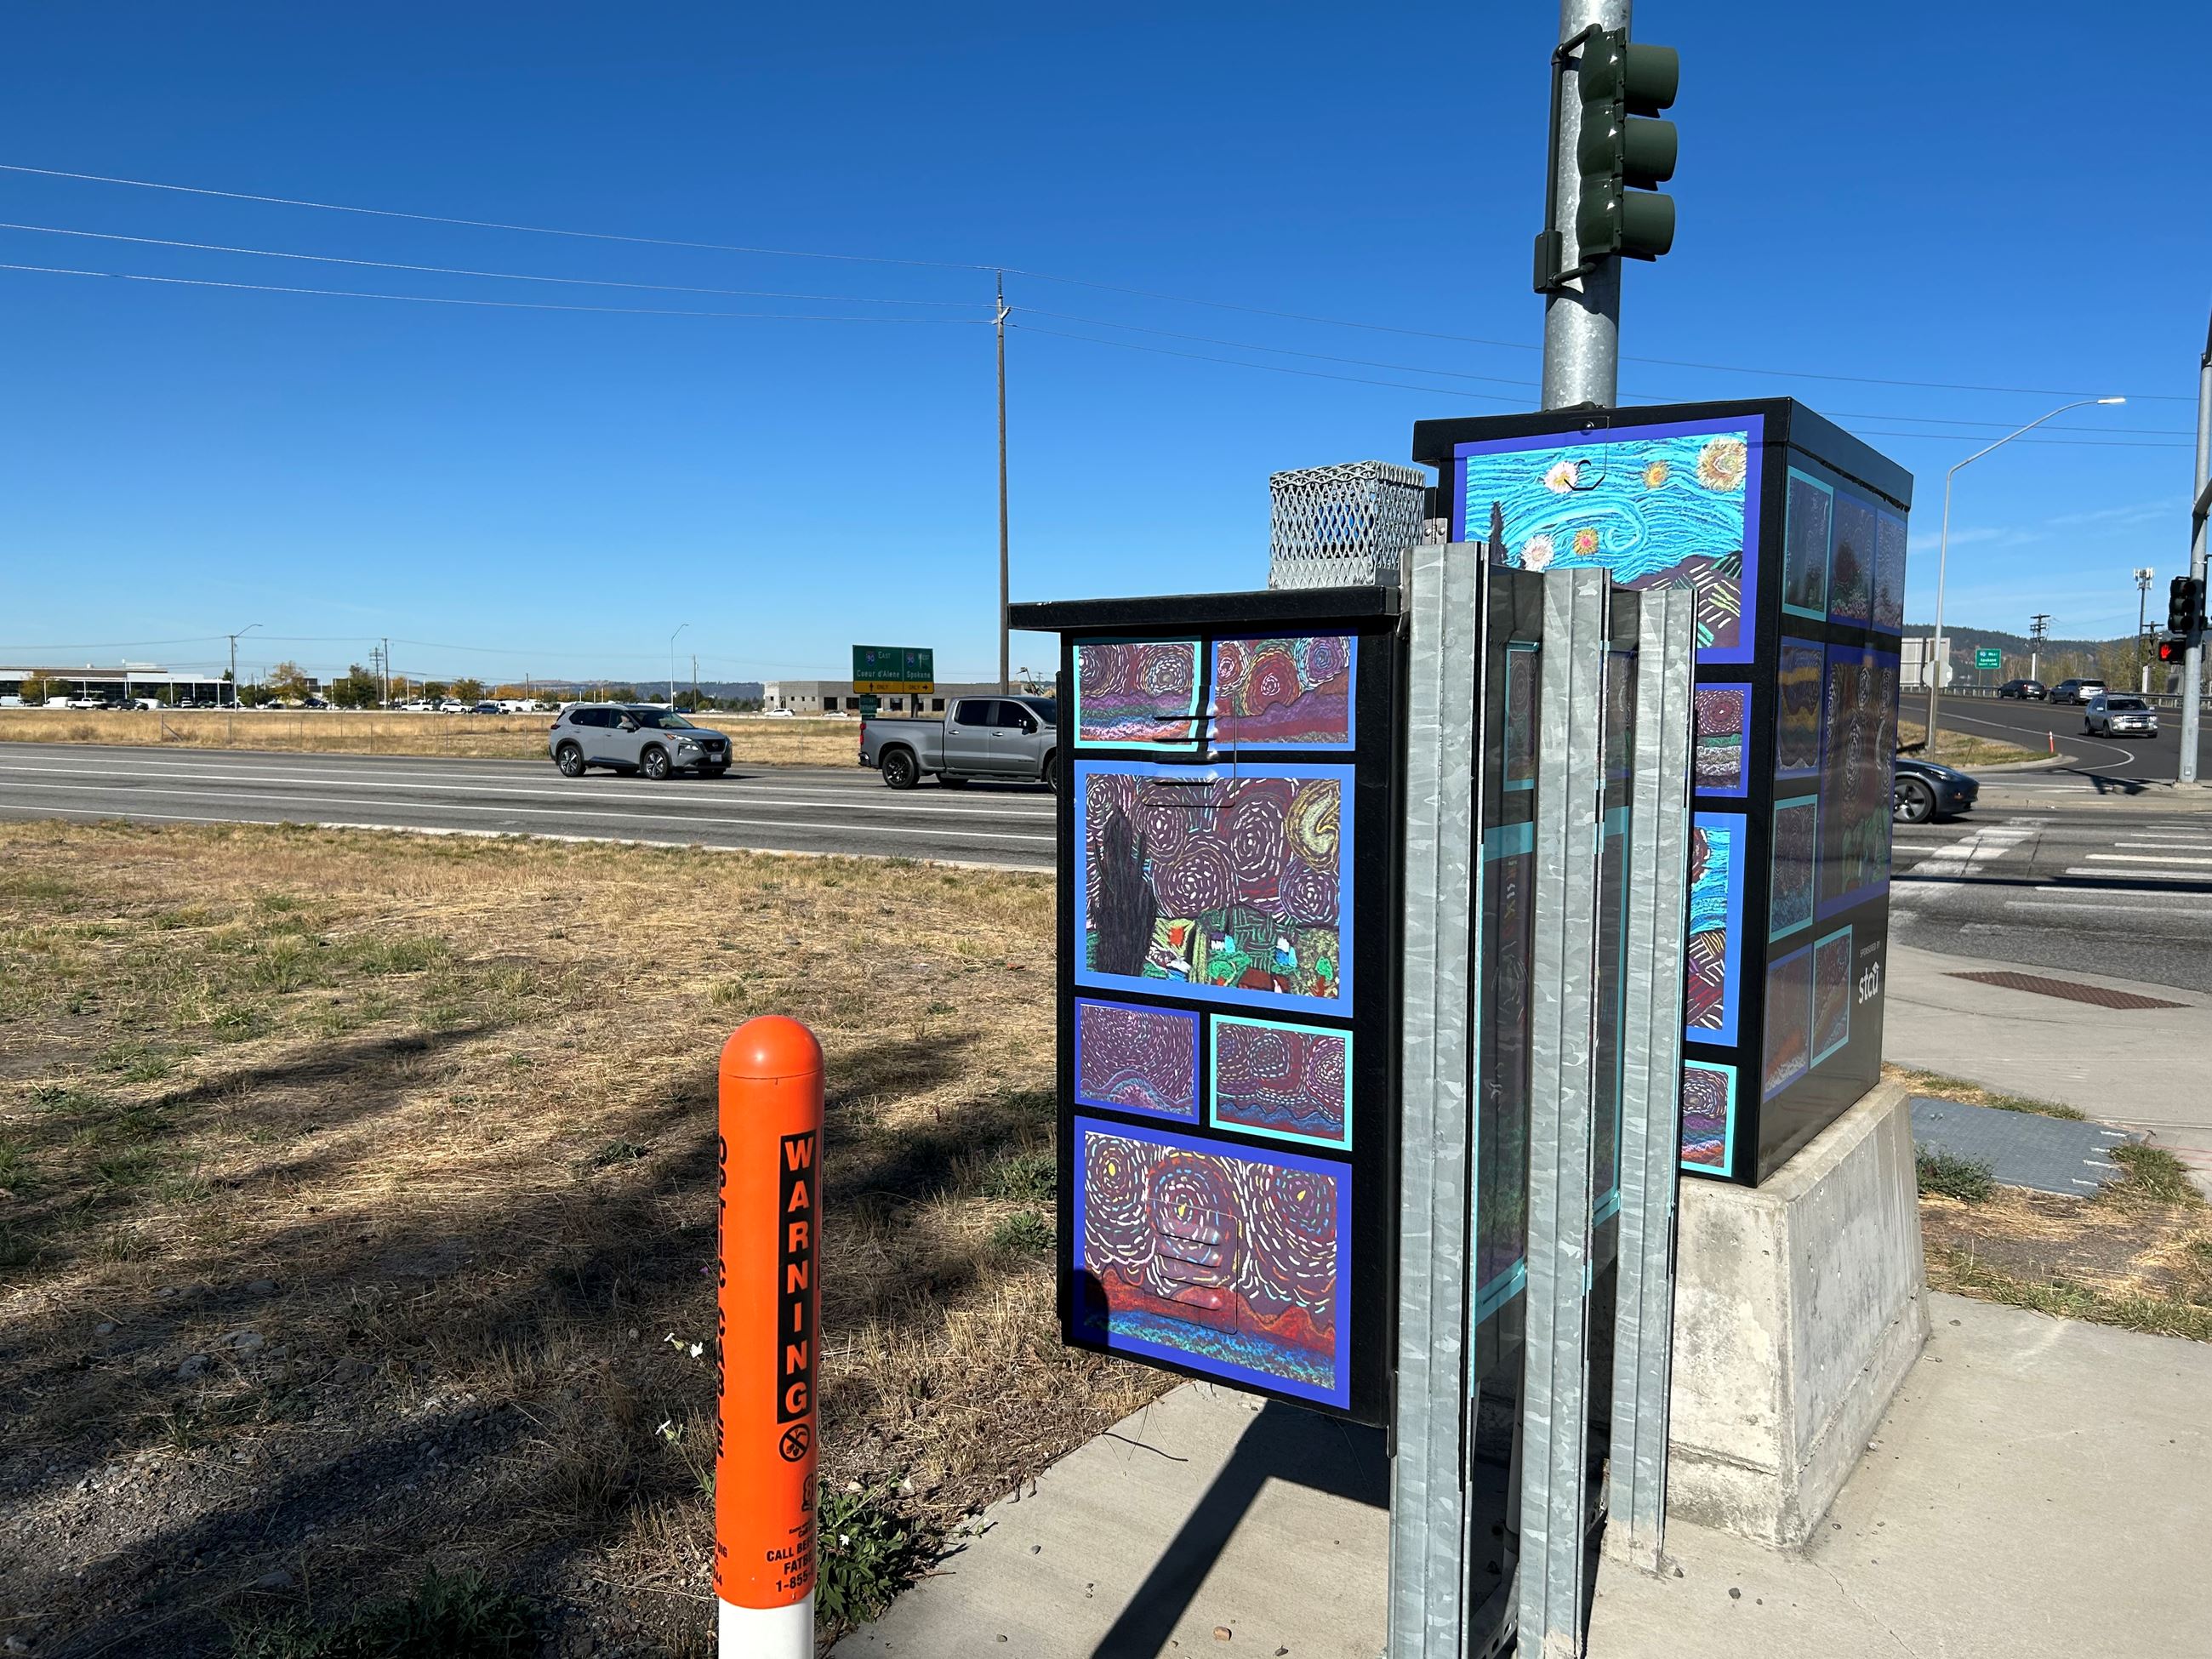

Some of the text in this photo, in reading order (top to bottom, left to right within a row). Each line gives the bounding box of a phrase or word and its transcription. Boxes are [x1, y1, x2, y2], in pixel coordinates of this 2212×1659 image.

[857, 670, 900, 678] Coeur d'Alene
[906, 670, 931, 680] Spokane
[1858, 961, 1879, 1005] stcu
[784, 1136, 814, 1416] WARNING
[767, 1546, 794, 1563] CALL
